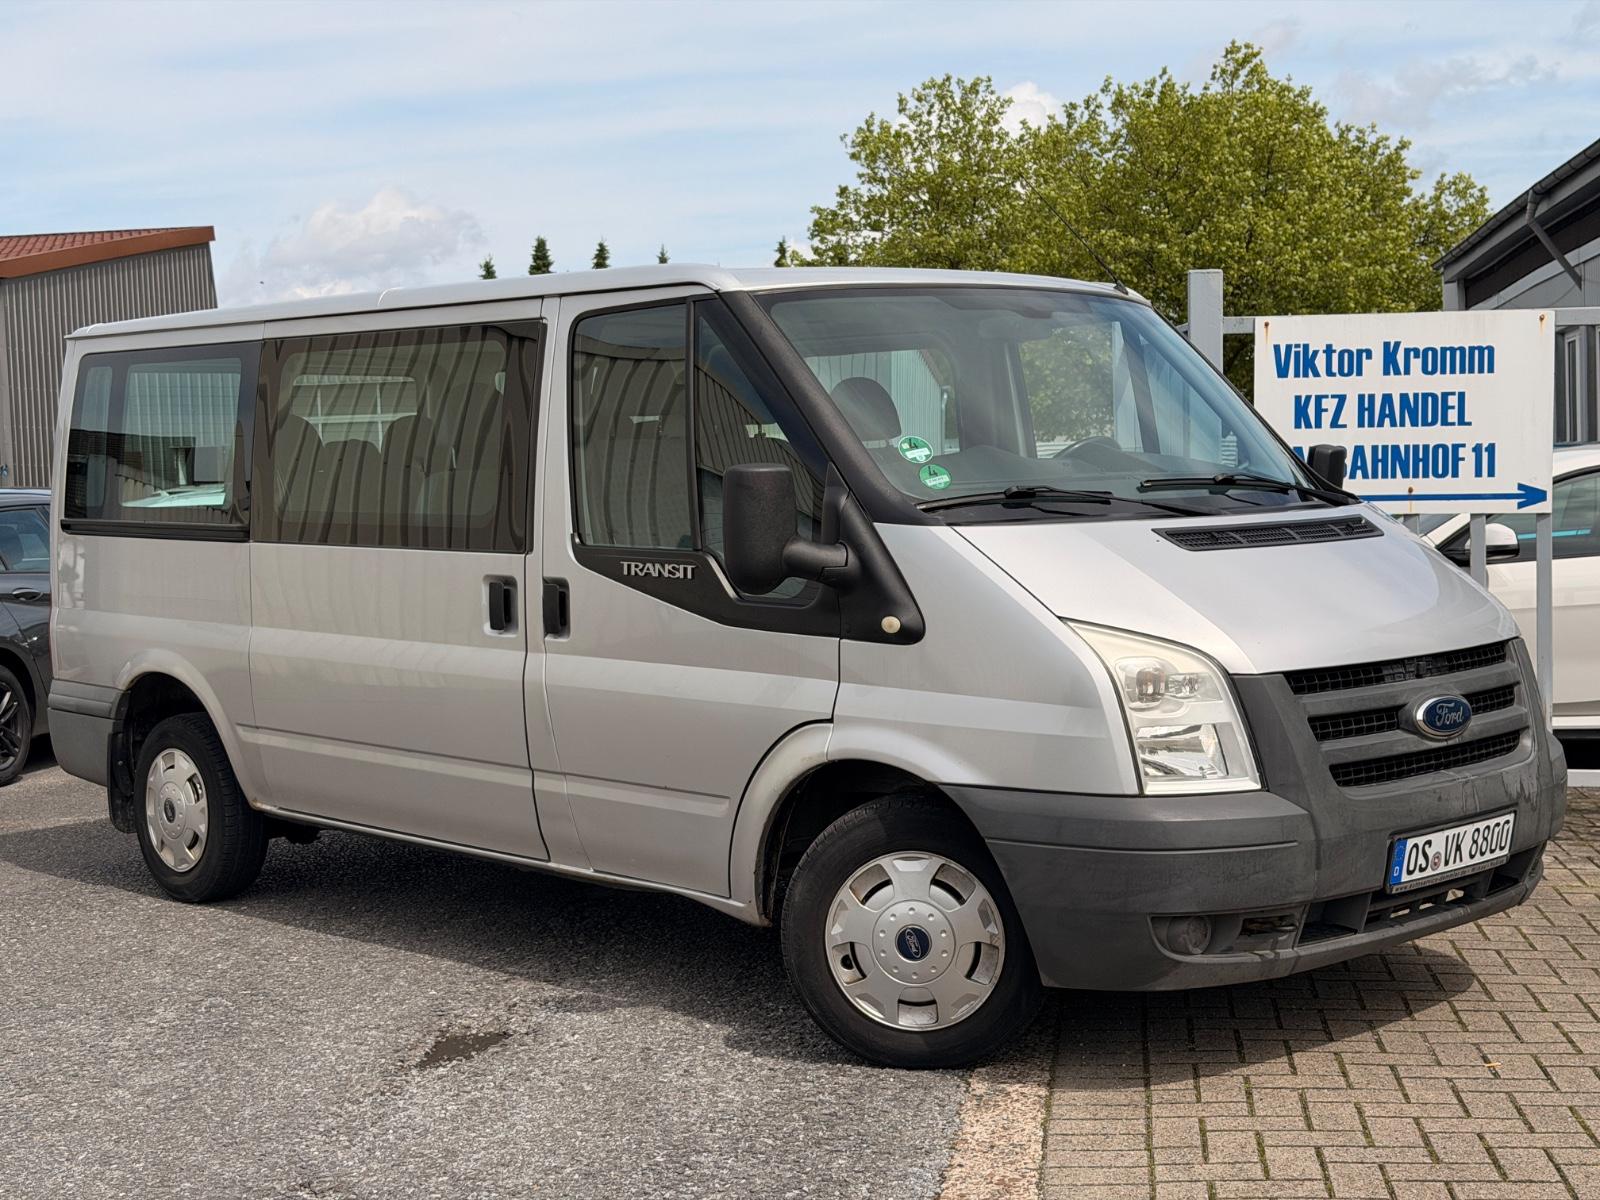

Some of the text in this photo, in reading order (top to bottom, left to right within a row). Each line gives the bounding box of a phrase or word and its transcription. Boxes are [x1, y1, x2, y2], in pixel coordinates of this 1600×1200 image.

[1273, 341, 1495, 378] Viktor Kromm
[1294, 391, 1472, 429] KFZ HANDEL
[928, 465, 938, 477] 4
[1343, 443, 1466, 480] AHNHOF
[1471, 442, 1496, 478] 11
[620, 561, 696, 579] TRANSIT
[1436, 702, 1464, 726] Ford
[1406, 839, 1433, 876] OS
[1444, 830, 1467, 867] VK
[1469, 819, 1511, 860] 8800
[1393, 866, 1400, 877] D
